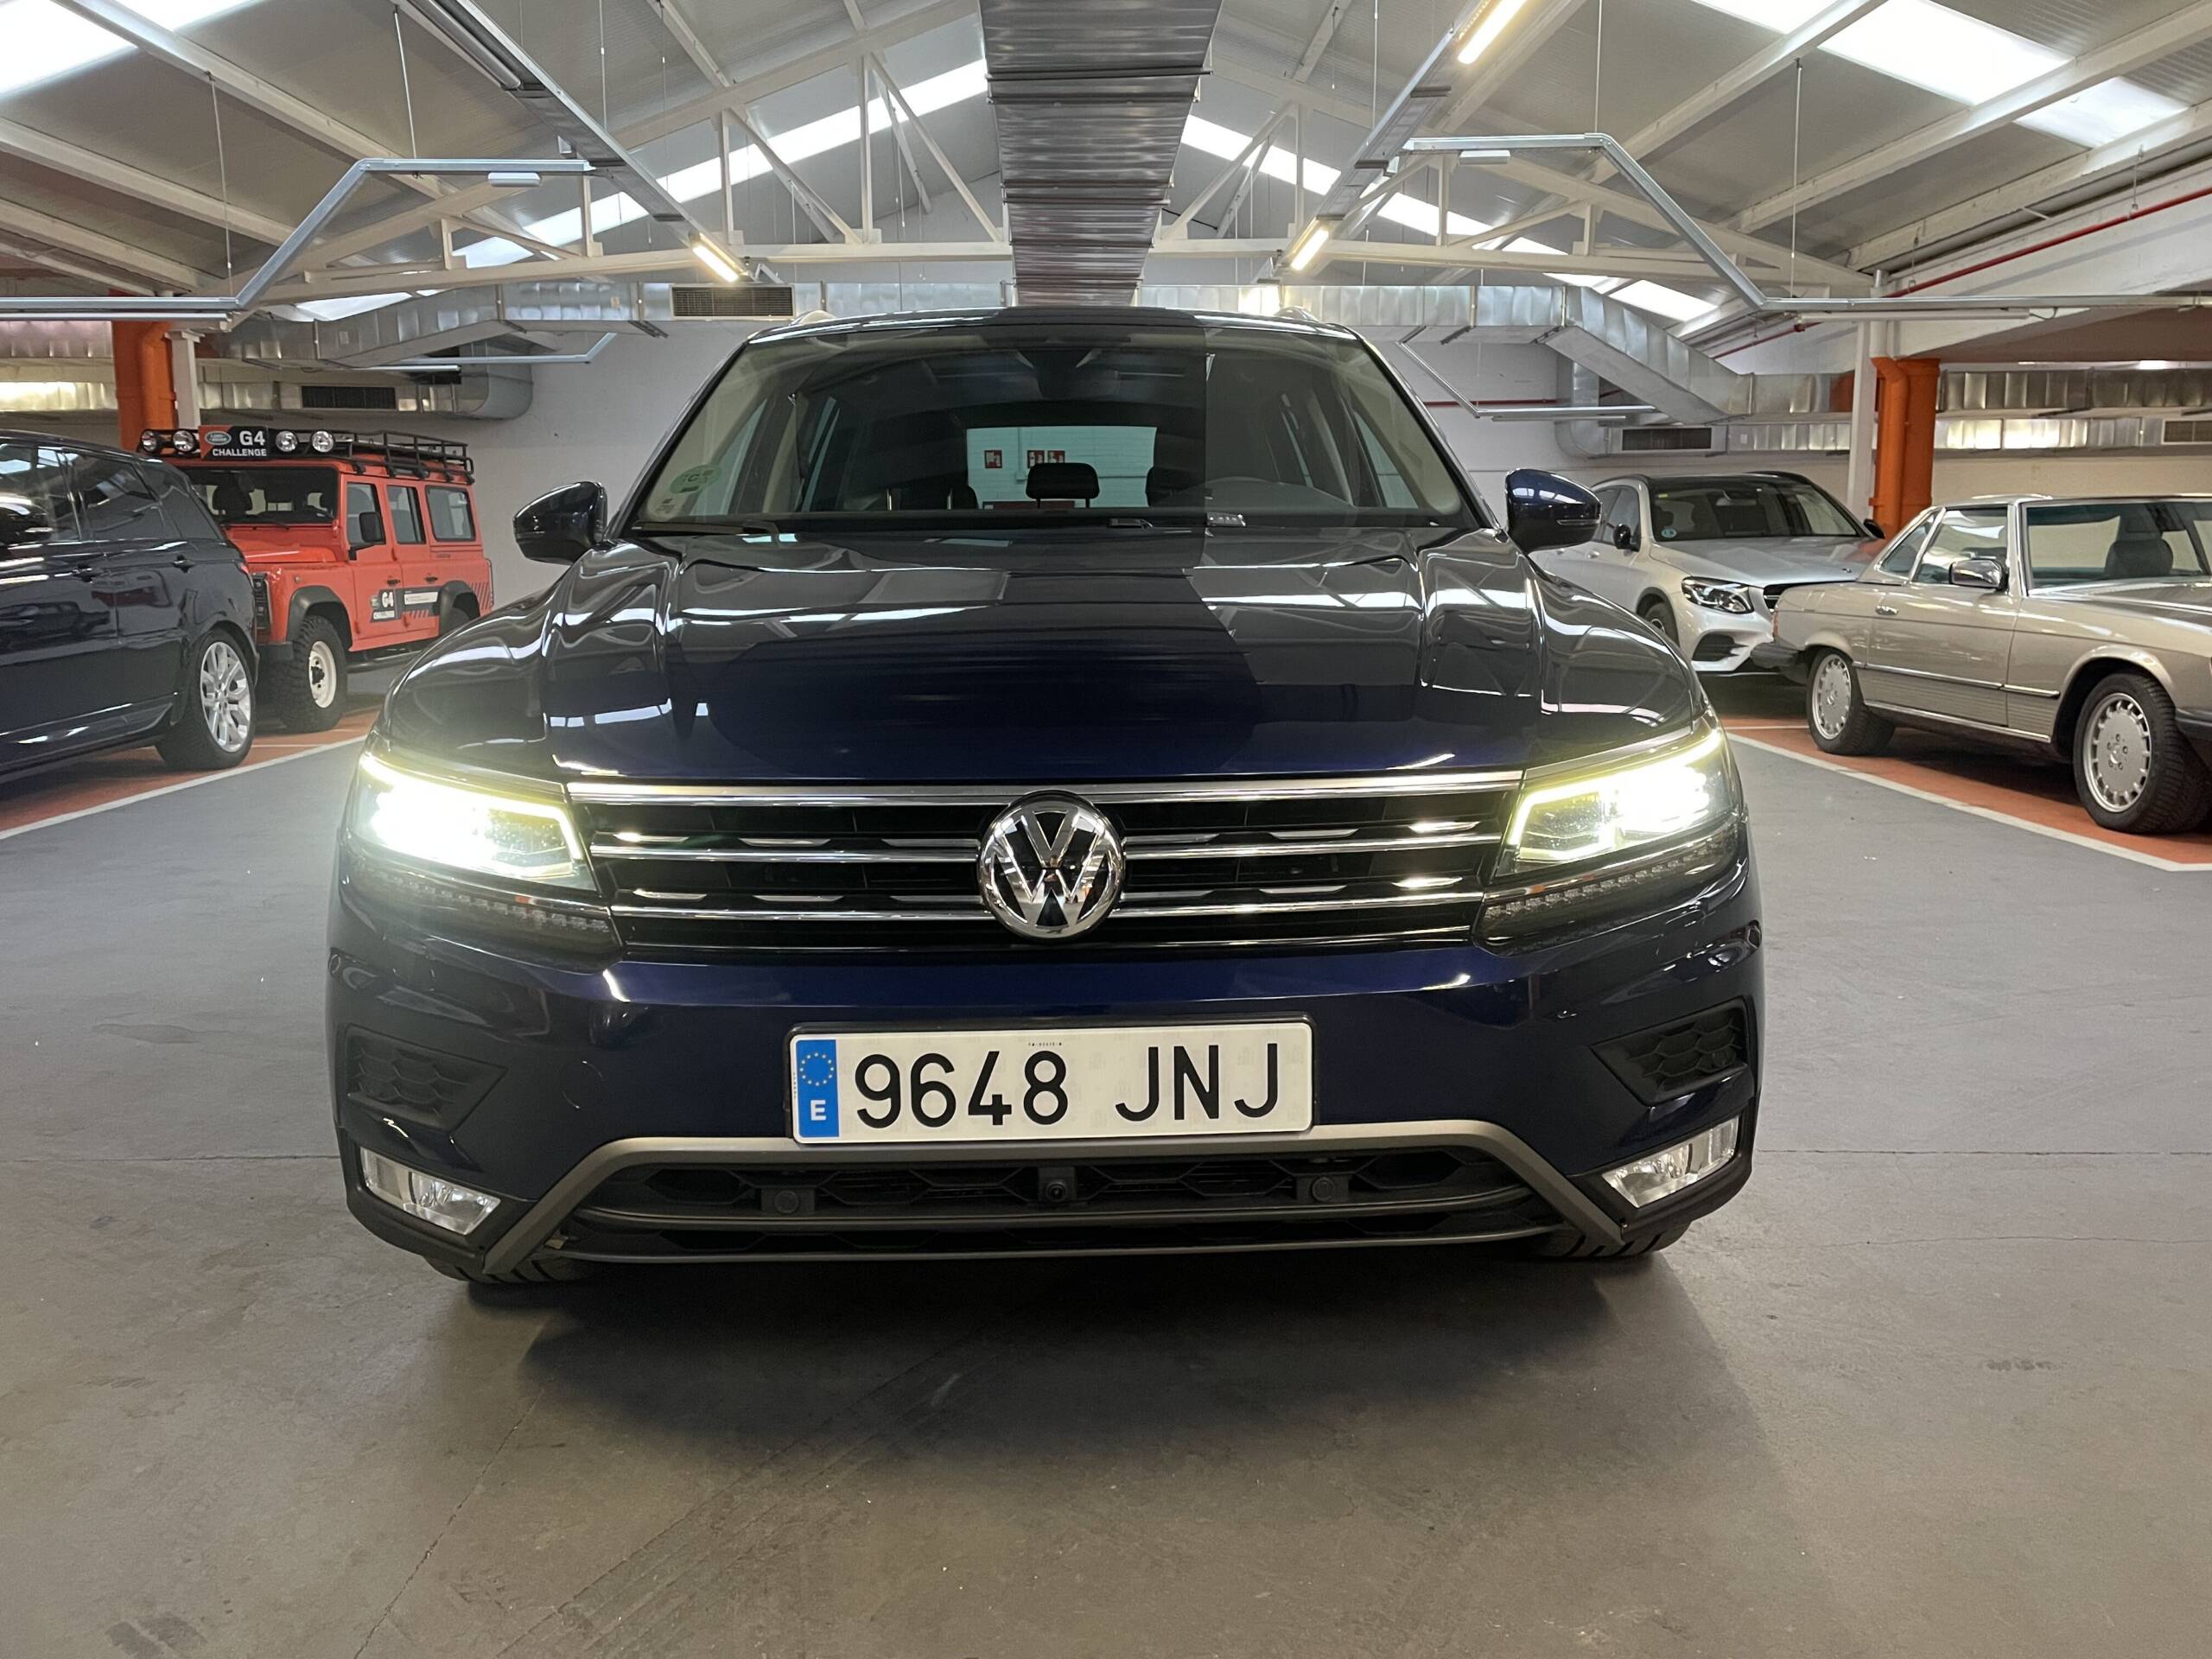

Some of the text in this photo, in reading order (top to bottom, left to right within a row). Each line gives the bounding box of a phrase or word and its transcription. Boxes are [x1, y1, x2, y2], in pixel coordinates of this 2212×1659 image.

[239, 430, 265, 446] G4
[212, 448, 267, 457] CHALLENGE
[855, 1043, 1278, 1128] 9648 JNJ
[810, 1099, 827, 1121] E
